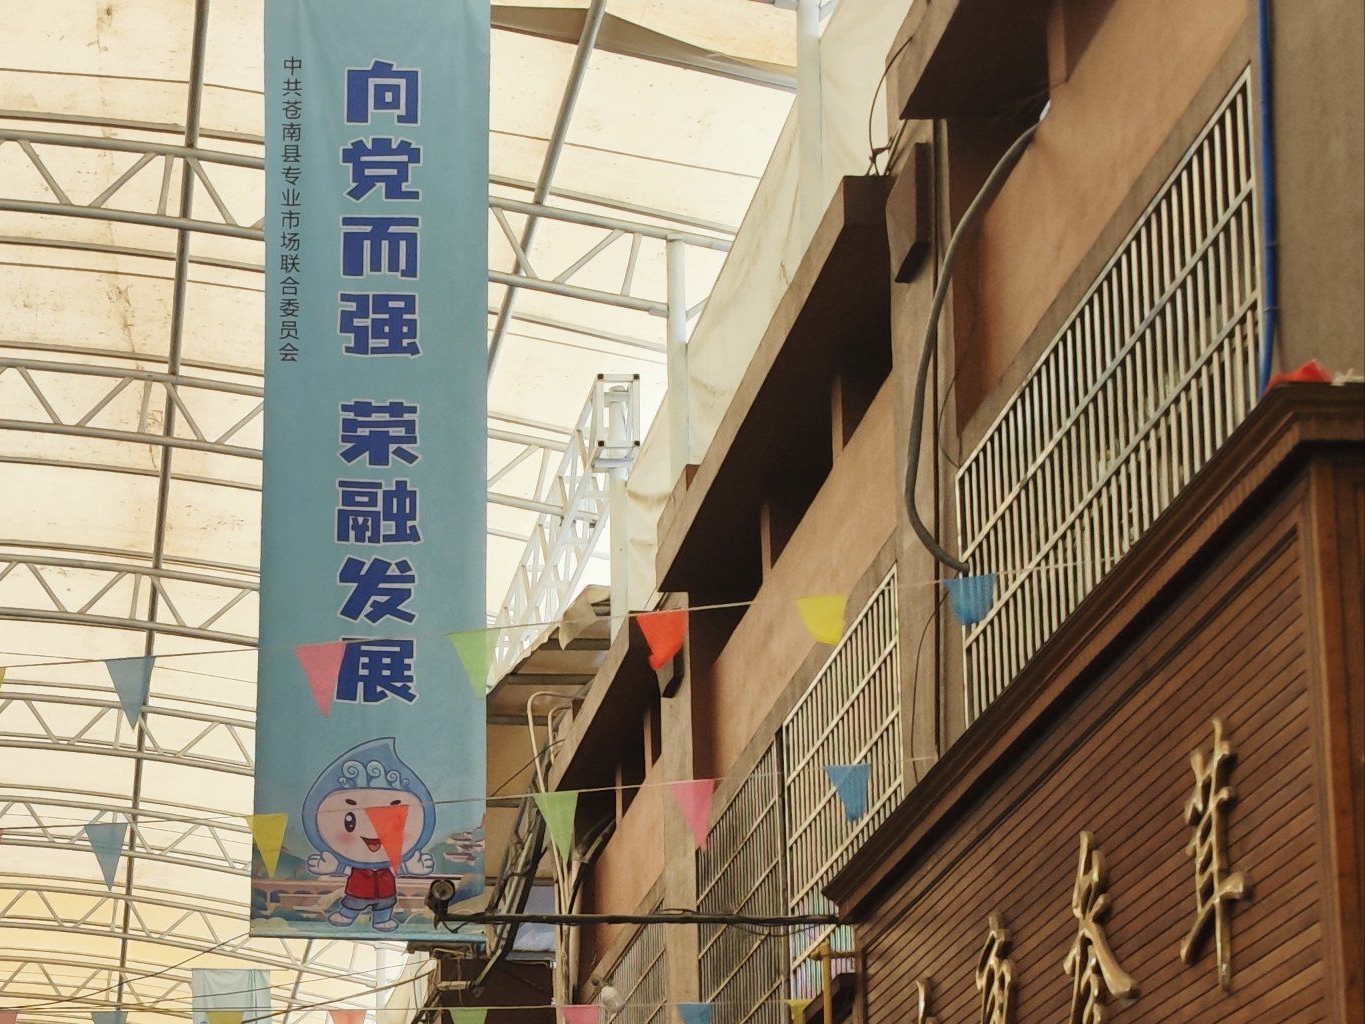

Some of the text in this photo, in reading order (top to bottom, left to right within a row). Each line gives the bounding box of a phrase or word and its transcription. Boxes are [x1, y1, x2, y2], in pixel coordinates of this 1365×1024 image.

[278, 55, 303, 363] 中共苍南县专业市场联合委员会
[335, 58, 423, 706] 向党而强 荣融发展
